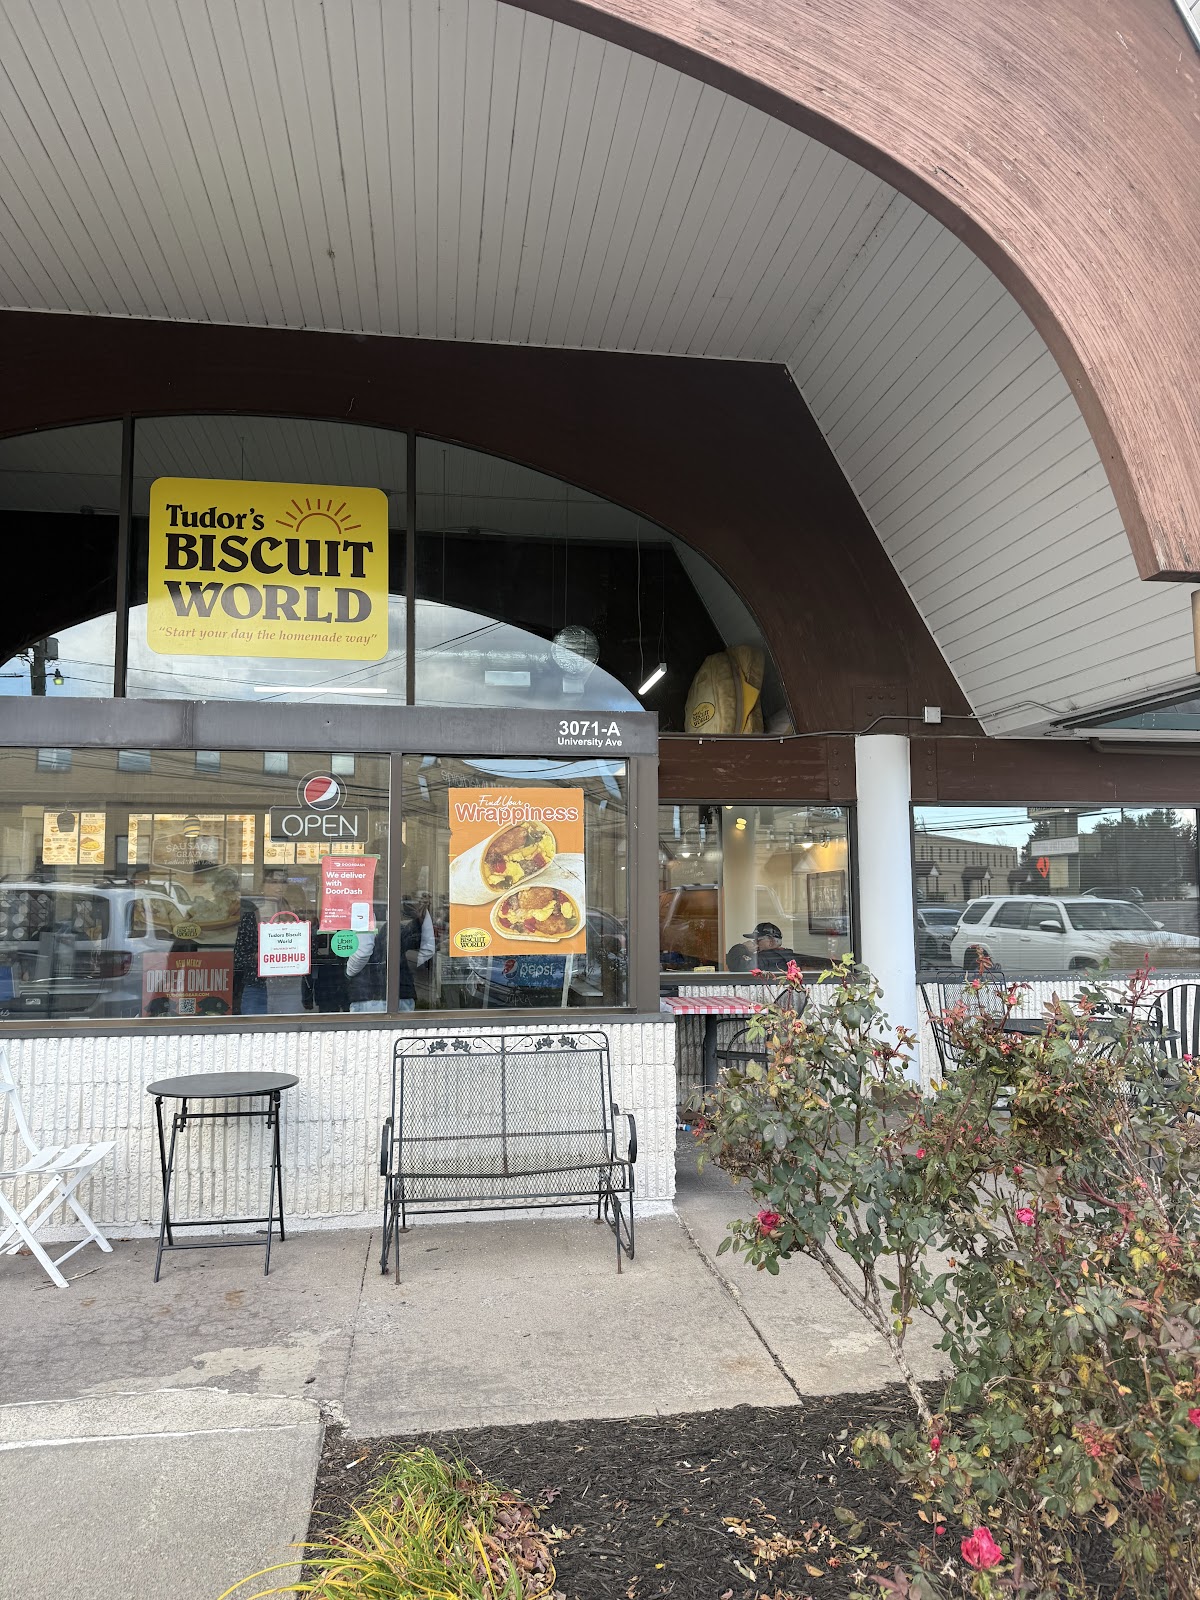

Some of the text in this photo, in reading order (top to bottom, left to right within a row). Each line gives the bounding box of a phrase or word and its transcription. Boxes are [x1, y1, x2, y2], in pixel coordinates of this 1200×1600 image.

[166, 504, 265, 530] Tudor's
[165, 532, 374, 578] BISCUIT
[164, 580, 372, 623] WORLD
[199, 629, 228, 640] your
[231, 629, 253, 642] day
[257, 629, 276, 640] the
[279, 630, 342, 642] homemade
[559, 720, 621, 736] 3071-A
[557, 737, 623, 747] University Ave
[478, 795, 523, 812] Find Your
[455, 803, 579, 826] Wrappiness
[282, 814, 358, 836] OPEN
[165, 842, 215, 853] SAUSAGE
[326, 871, 367, 879] We deliver
[175, 959, 203, 969] NEW MERCH
[263, 953, 306, 963] GRUBHUB
[519, 962, 554, 977] pepsi
[146, 968, 230, 993] ORDER ONLINE
